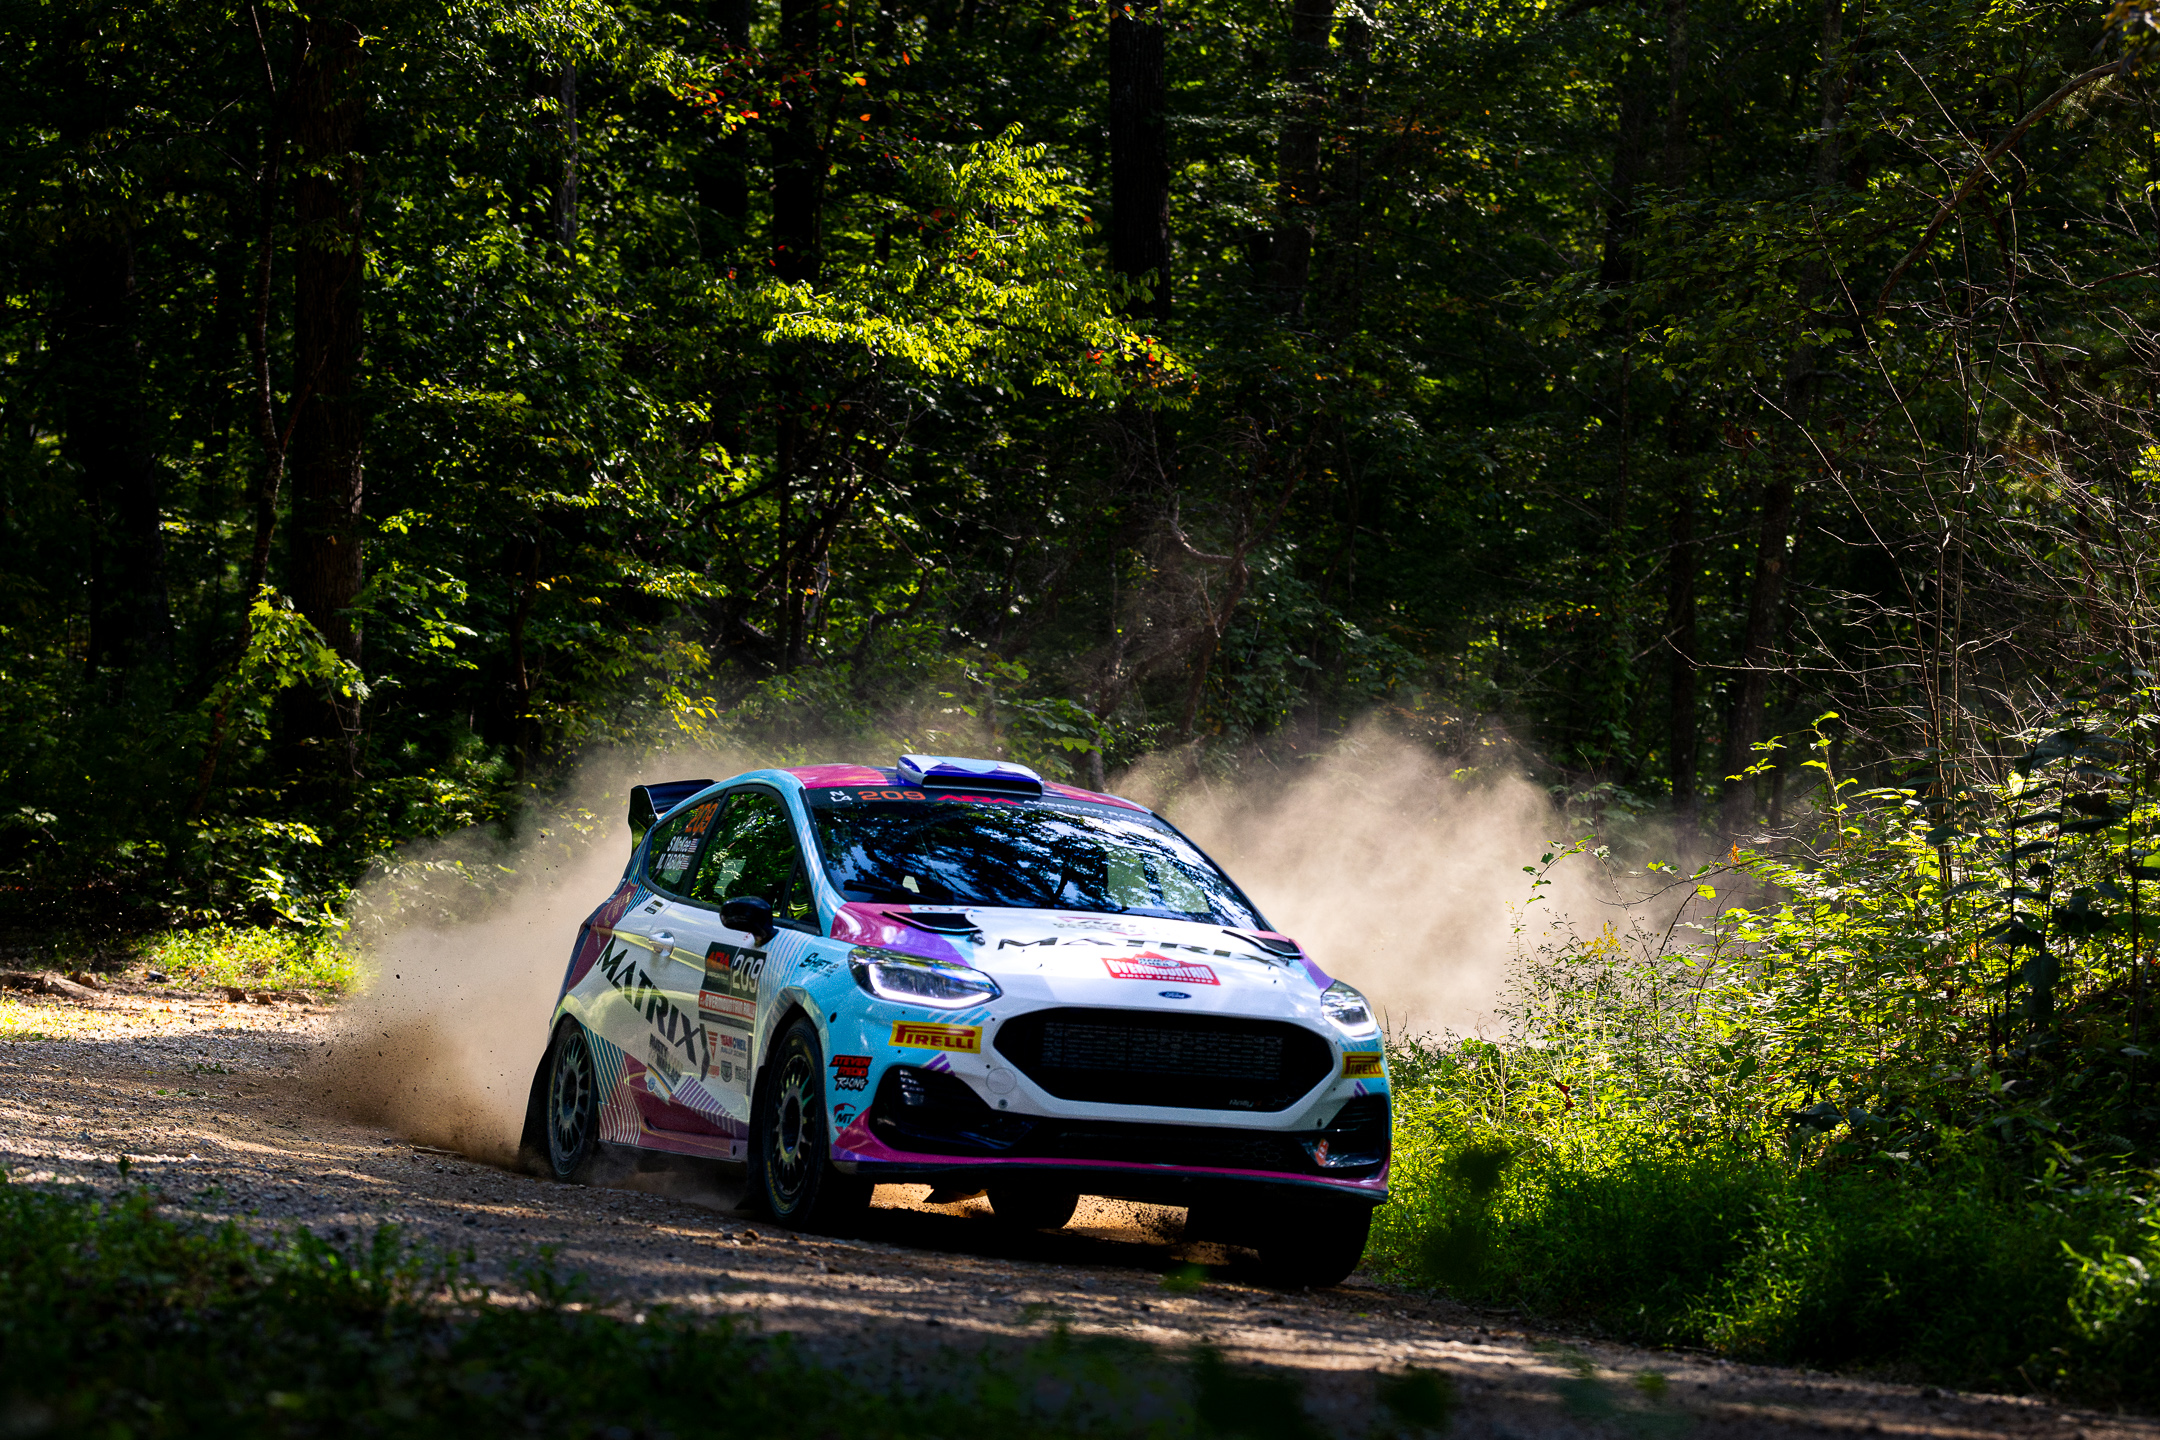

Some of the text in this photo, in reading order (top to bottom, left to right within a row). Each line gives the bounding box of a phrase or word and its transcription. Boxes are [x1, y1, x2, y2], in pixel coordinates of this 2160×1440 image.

[857, 790, 926, 801] 209
[936, 793, 1022, 806] ARA
[684, 803, 719, 833] 209
[997, 936, 1290, 968] MATRIX
[732, 954, 764, 994] 209
[596, 933, 701, 1067] MATRIX
[894, 1024, 976, 1050] PIRELLI
[831, 1055, 873, 1067] STEVEN
[1345, 1055, 1383, 1075] PIRELLI
[834, 1112, 856, 1124] MT
